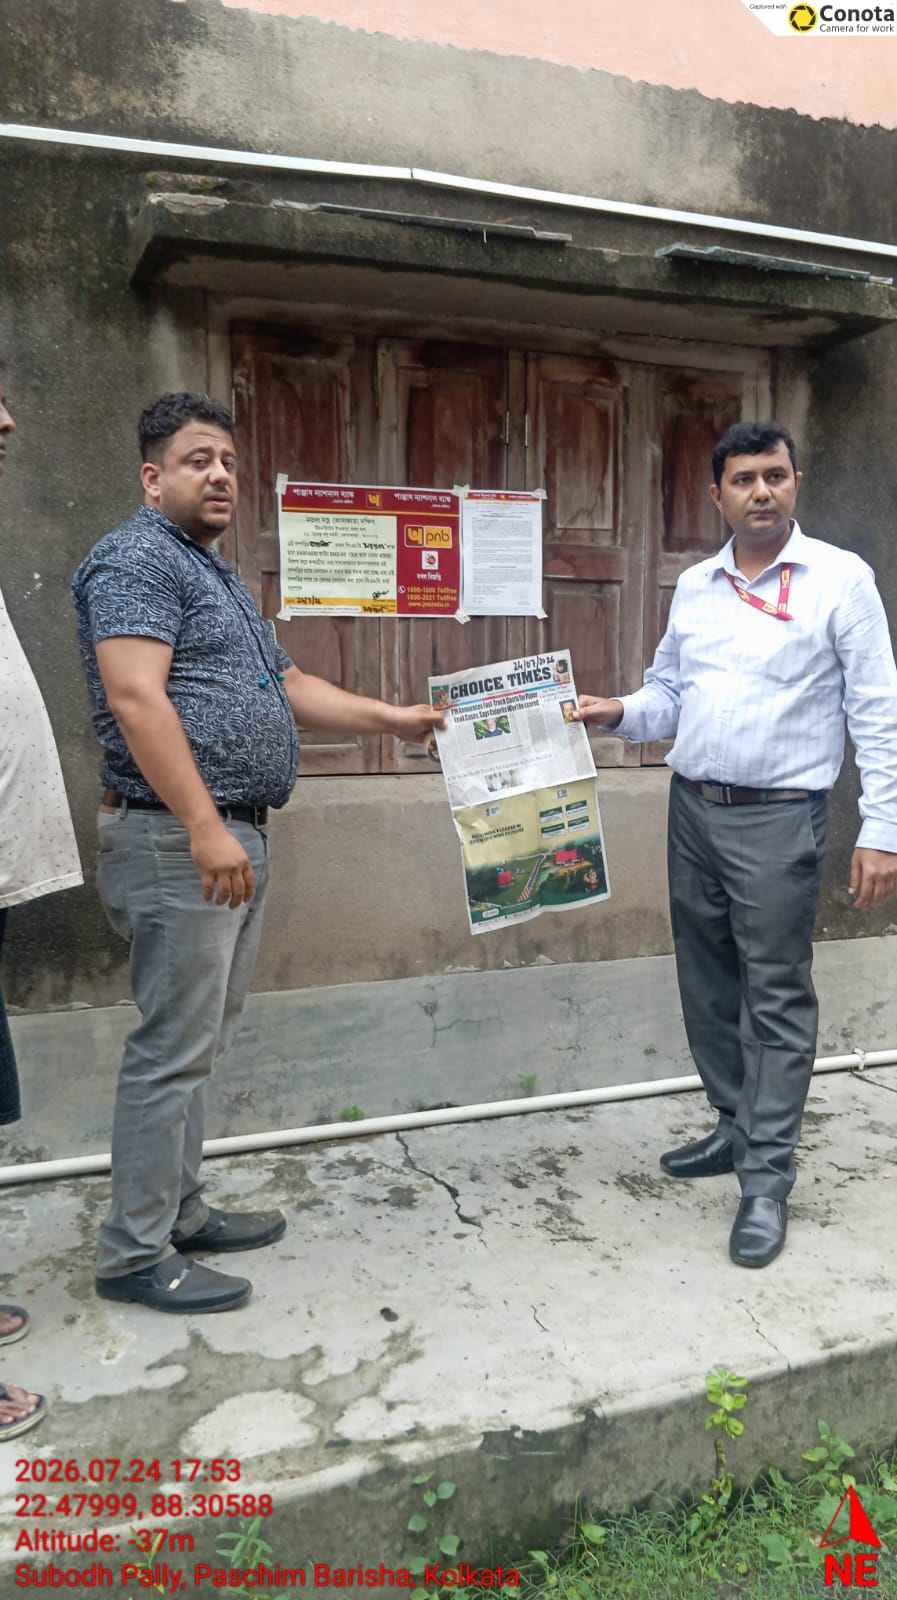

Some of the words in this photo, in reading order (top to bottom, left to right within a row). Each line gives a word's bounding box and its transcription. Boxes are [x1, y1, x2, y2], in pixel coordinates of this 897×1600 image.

[426, 529, 450, 545] pnb
[450, 675, 504, 700] CHOICE
[506, 666, 552, 688] TIMES
